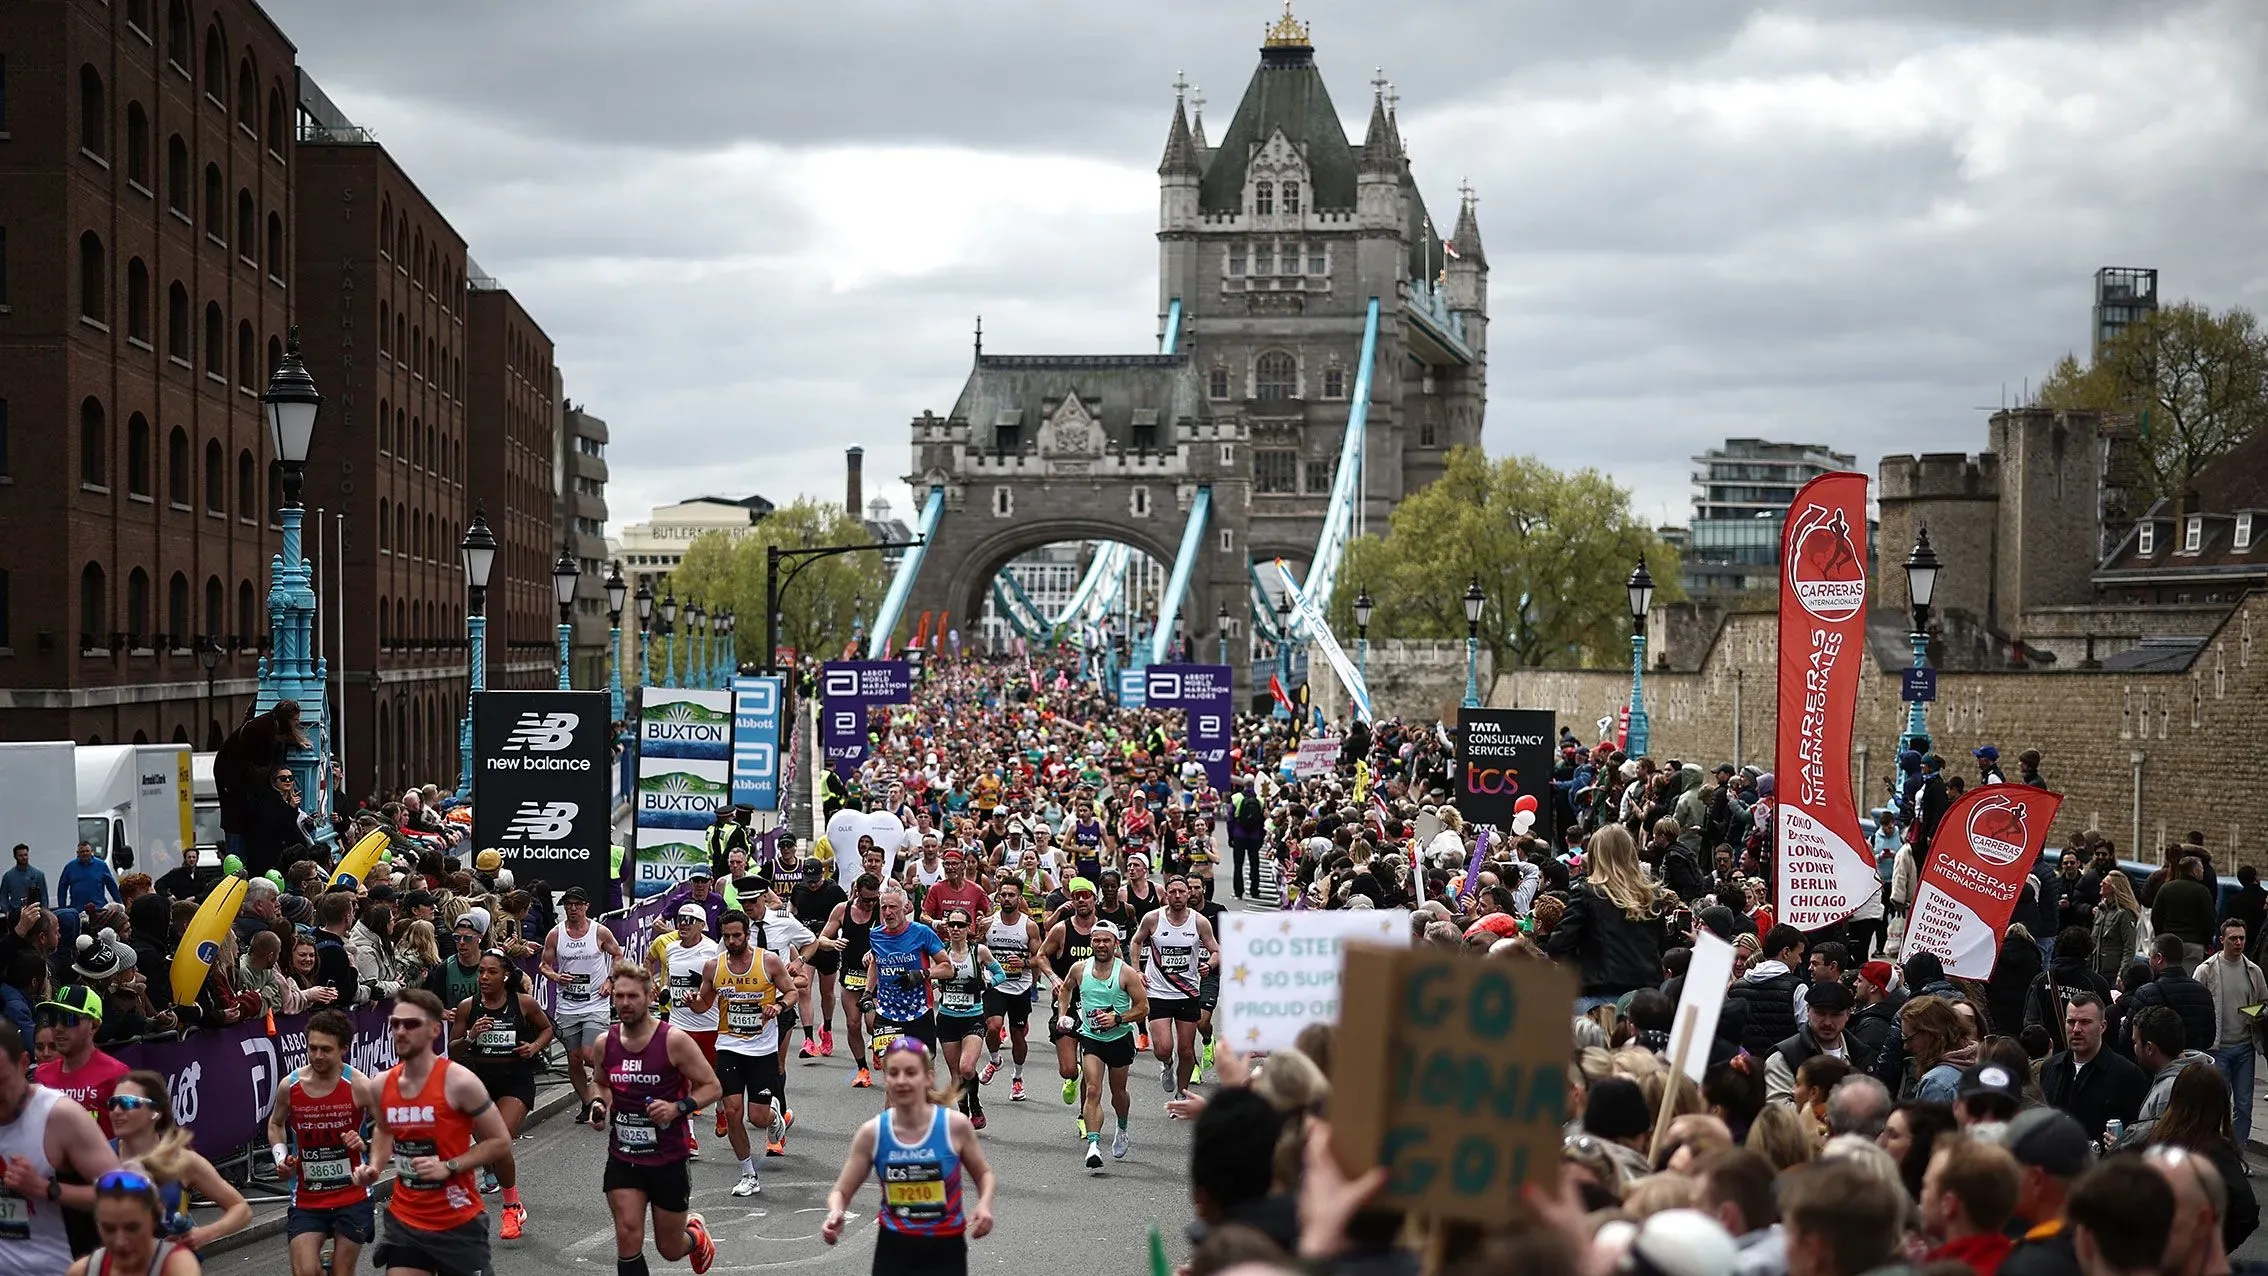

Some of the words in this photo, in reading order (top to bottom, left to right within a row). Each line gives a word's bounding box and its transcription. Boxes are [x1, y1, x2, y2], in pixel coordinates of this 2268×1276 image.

[341, 257, 354, 426] KATHARINE
[653, 527, 703, 540] BUTLERS
[1801, 583, 1863, 597] CARRERAS
[1809, 598, 1860, 606] INTERNACIONALES
[735, 718, 774, 729] Abbott
[1800, 629, 1826, 806] CARRERAS
[1812, 632, 1843, 807] INTERNACIONALES
[648, 723, 722, 741] BUXTON
[1469, 722, 1501, 732] TATA
[1468, 733, 1544, 745] CONSULTANCY
[1468, 746, 1516, 756] SERVICES
[487, 757, 520, 770] new
[523, 756, 591, 771] balance
[732, 780, 772, 790] Abbott
[1467, 761, 1518, 795] tcs
[645, 794, 720, 812] BUXTON
[1786, 814, 1812, 830] TOKIO
[1788, 829, 1826, 846] BOSTON
[492, 848, 520, 859] ew
[523, 845, 590, 860] balance
[1788, 845, 1834, 860] LONDON
[1973, 836, 2021, 856] CARRERAS
[1977, 845, 2014, 860] INTERNACIONALES
[643, 864, 690, 880] BUXT
[1789, 861, 1834, 875] SYDNEY
[1938, 853, 2017, 893] CARRERAS
[775, 872, 803, 880] NATHAN
[1933, 863, 2015, 901] INTERNACIONALES
[1791, 878, 1837, 890] BERLIN
[1790, 895, 1846, 907] CHICAGO
[1929, 892, 1956, 909] TOKIO
[1789, 912, 1819, 923] NEW
[1925, 902, 1963, 921] BOSTON
[1921, 912, 1961, 932] LONDON
[1917, 922, 1954, 939] SYDNEY
[1914, 932, 1949, 946] BERLIN
[1070, 946, 1093, 956] GIDD
[1249, 938, 1284, 957] GO
[1911, 942, 1952, 956] CHICAGO
[1939, 956, 1958, 967] ORK
[721, 977, 758, 985] JAMES
[1262, 971, 1289, 987] SO
[1294, 970, 1342, 987] SUP
[452, 983, 478, 996] PAU
[2044, 983, 2065, 991] MY
[947, 995, 969, 1003] 39544
[1406, 964, 1517, 1041] GO
[1233, 1001, 1304, 1018] PROUD
[732, 1016, 757, 1025] 41617
[281, 1031, 307, 1053] ABBO
[482, 1033, 510, 1044] 38664
[284, 1054, 310, 1073] WOR
[621, 1059, 642, 1071] BEN
[610, 1072, 661, 1085] mencap
[620, 1129, 649, 1141] 49253
[888, 1148, 936, 1161] BIANCA
[309, 1163, 344, 1177] 38630
[897, 1186, 932, 1201] 7210
